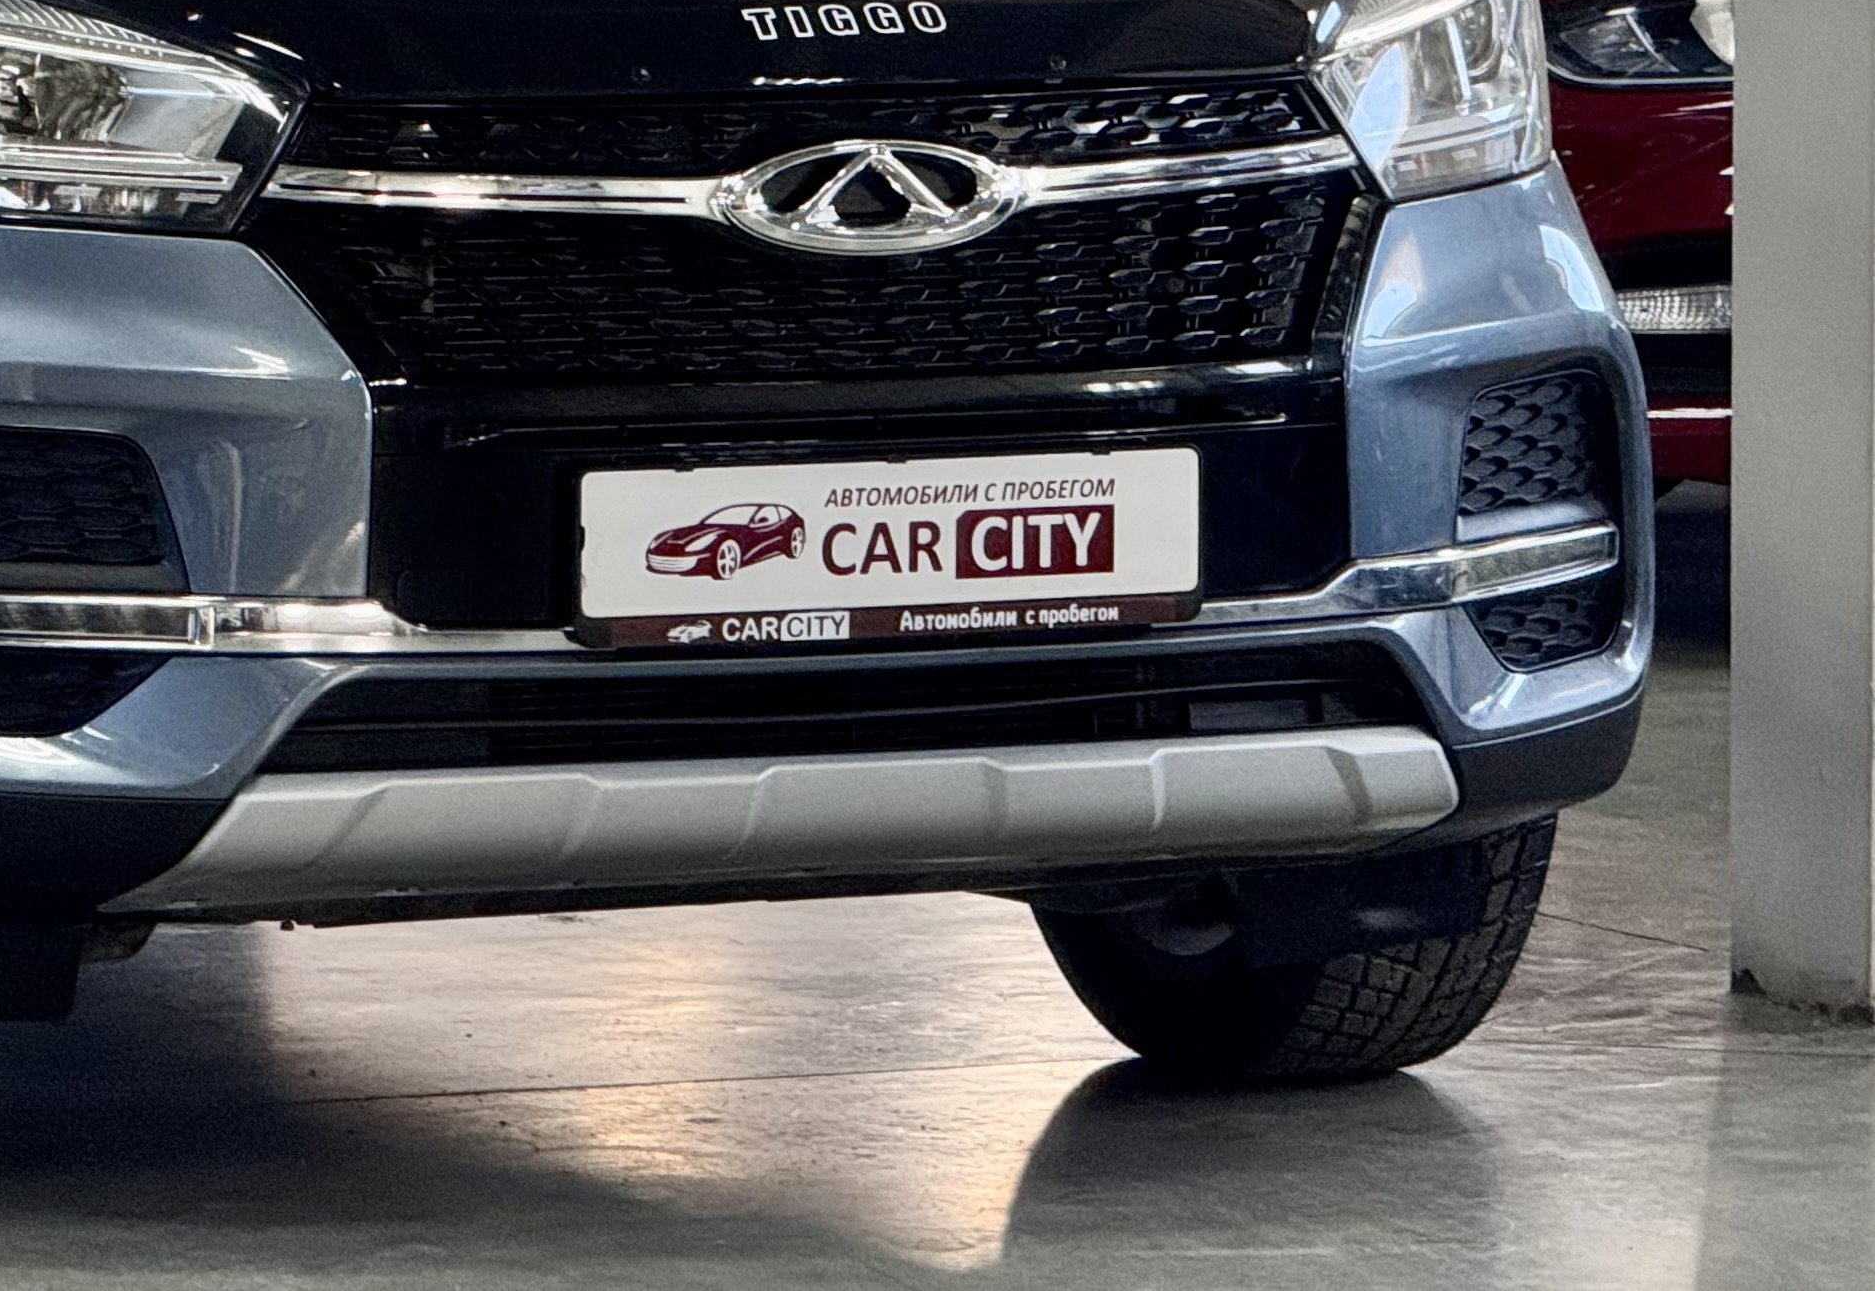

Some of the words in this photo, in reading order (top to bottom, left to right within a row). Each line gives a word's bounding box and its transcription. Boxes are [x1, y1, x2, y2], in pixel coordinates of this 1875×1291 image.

[740, 1, 947, 41] TIGGO
[824, 483, 979, 508] АВТОМОБИЛИ
[984, 482, 997, 502] С
[1001, 478, 1115, 501] ПРОБЕГОМ
[822, 520, 943, 576] CAR
[971, 512, 1102, 572] CITY
[899, 606, 1018, 632] Автомобили
[1024, 610, 1036, 626] с
[1038, 603, 1120, 629] пробегом
